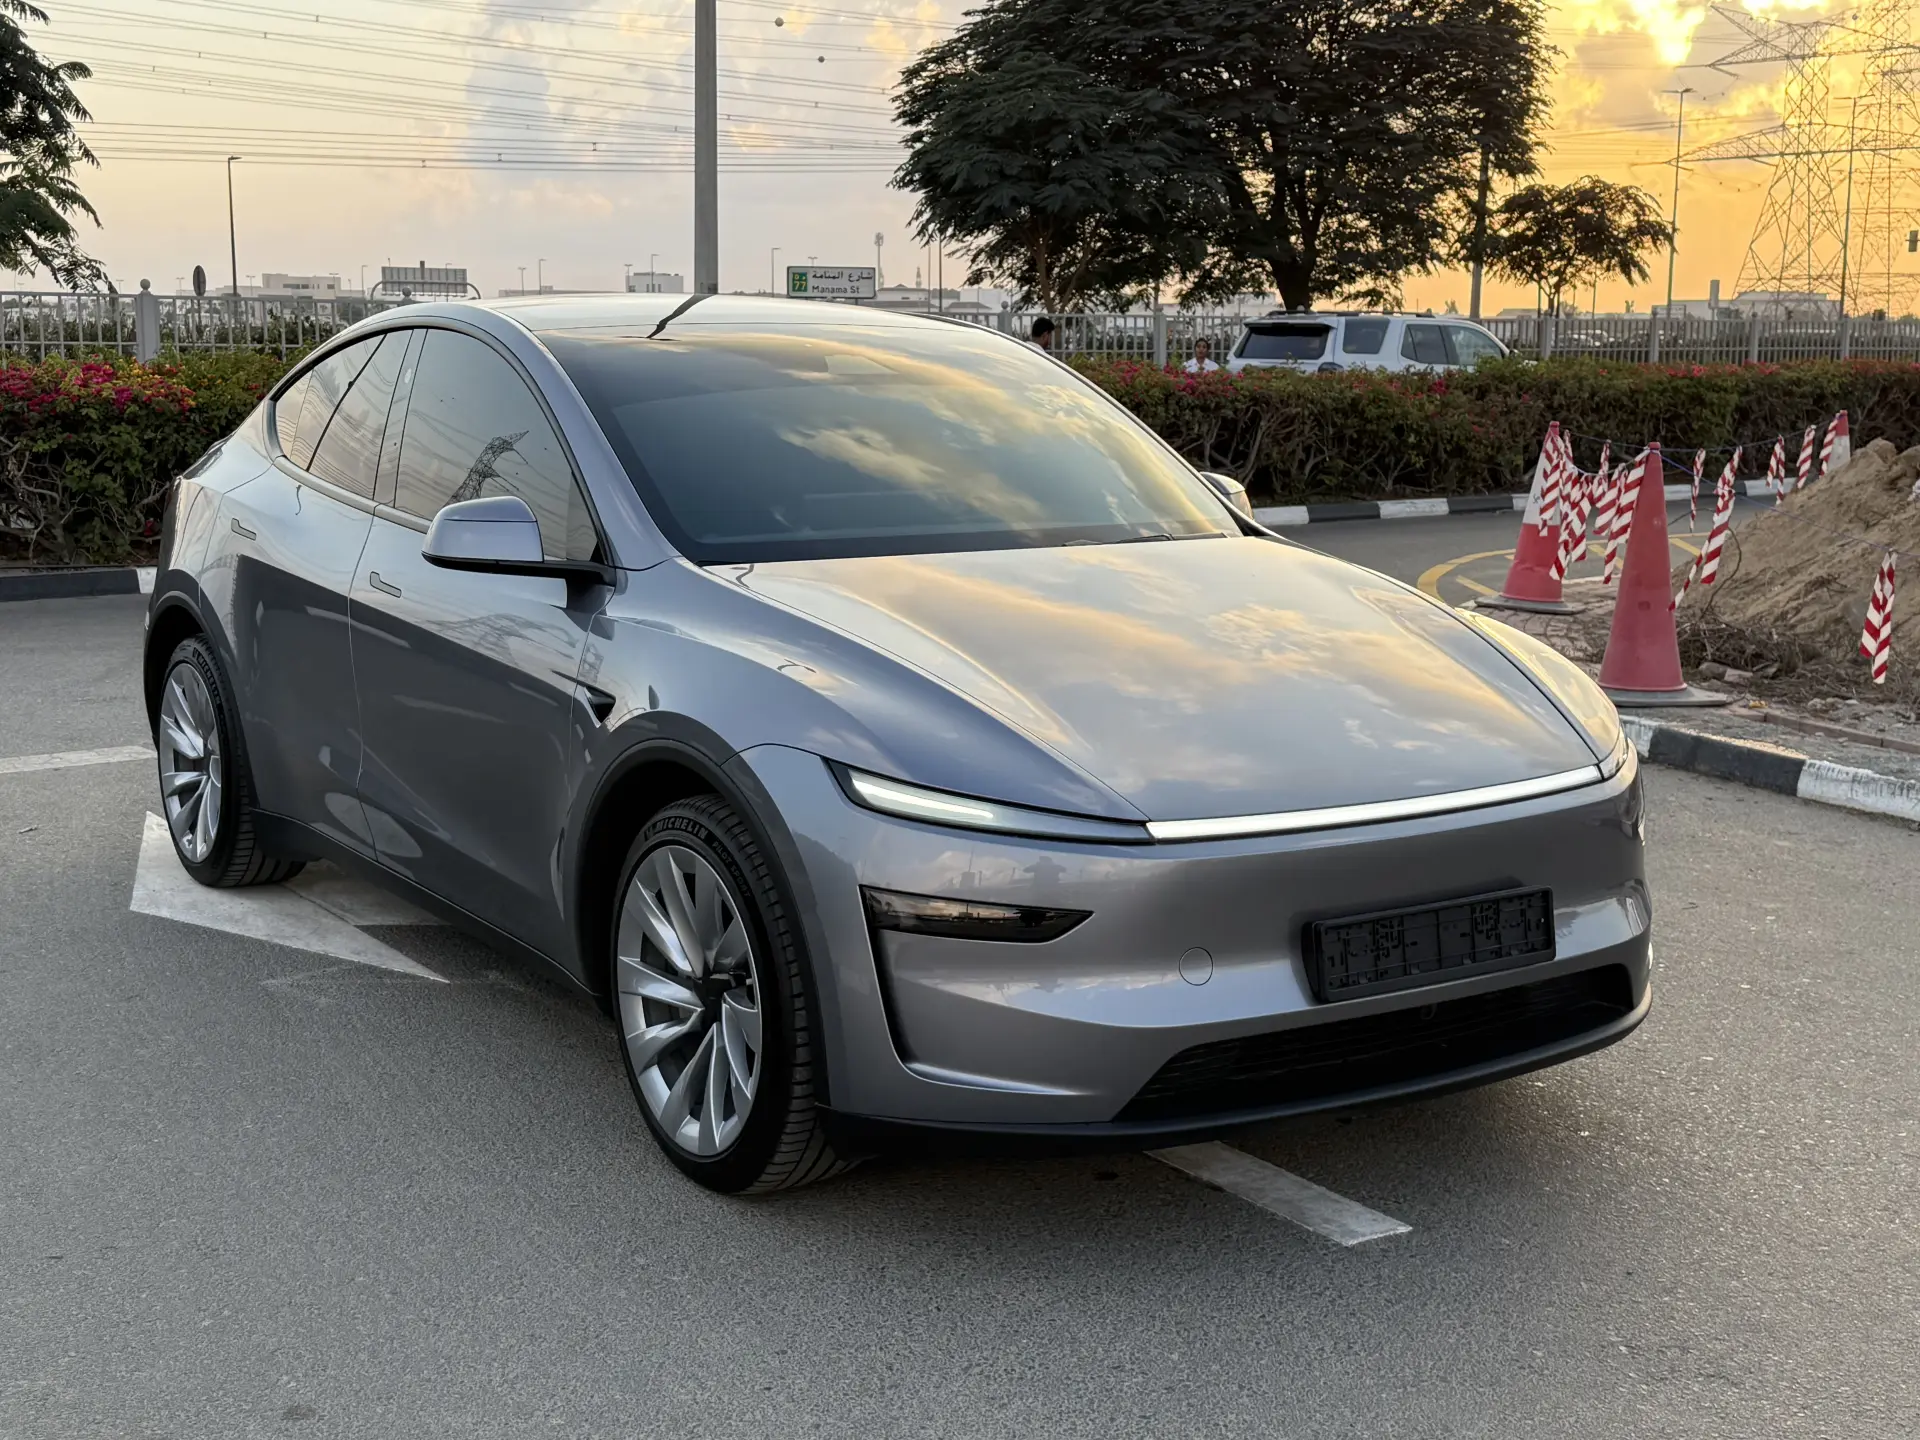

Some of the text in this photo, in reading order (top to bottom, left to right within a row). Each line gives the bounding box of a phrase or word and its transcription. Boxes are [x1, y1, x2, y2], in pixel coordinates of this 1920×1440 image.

[812, 271, 874, 283] شارع المنامة
[794, 281, 807, 290] 77
[812, 285, 860, 294] Manama St
[655, 816, 752, 898] MICHELIN PILOT SPORT
